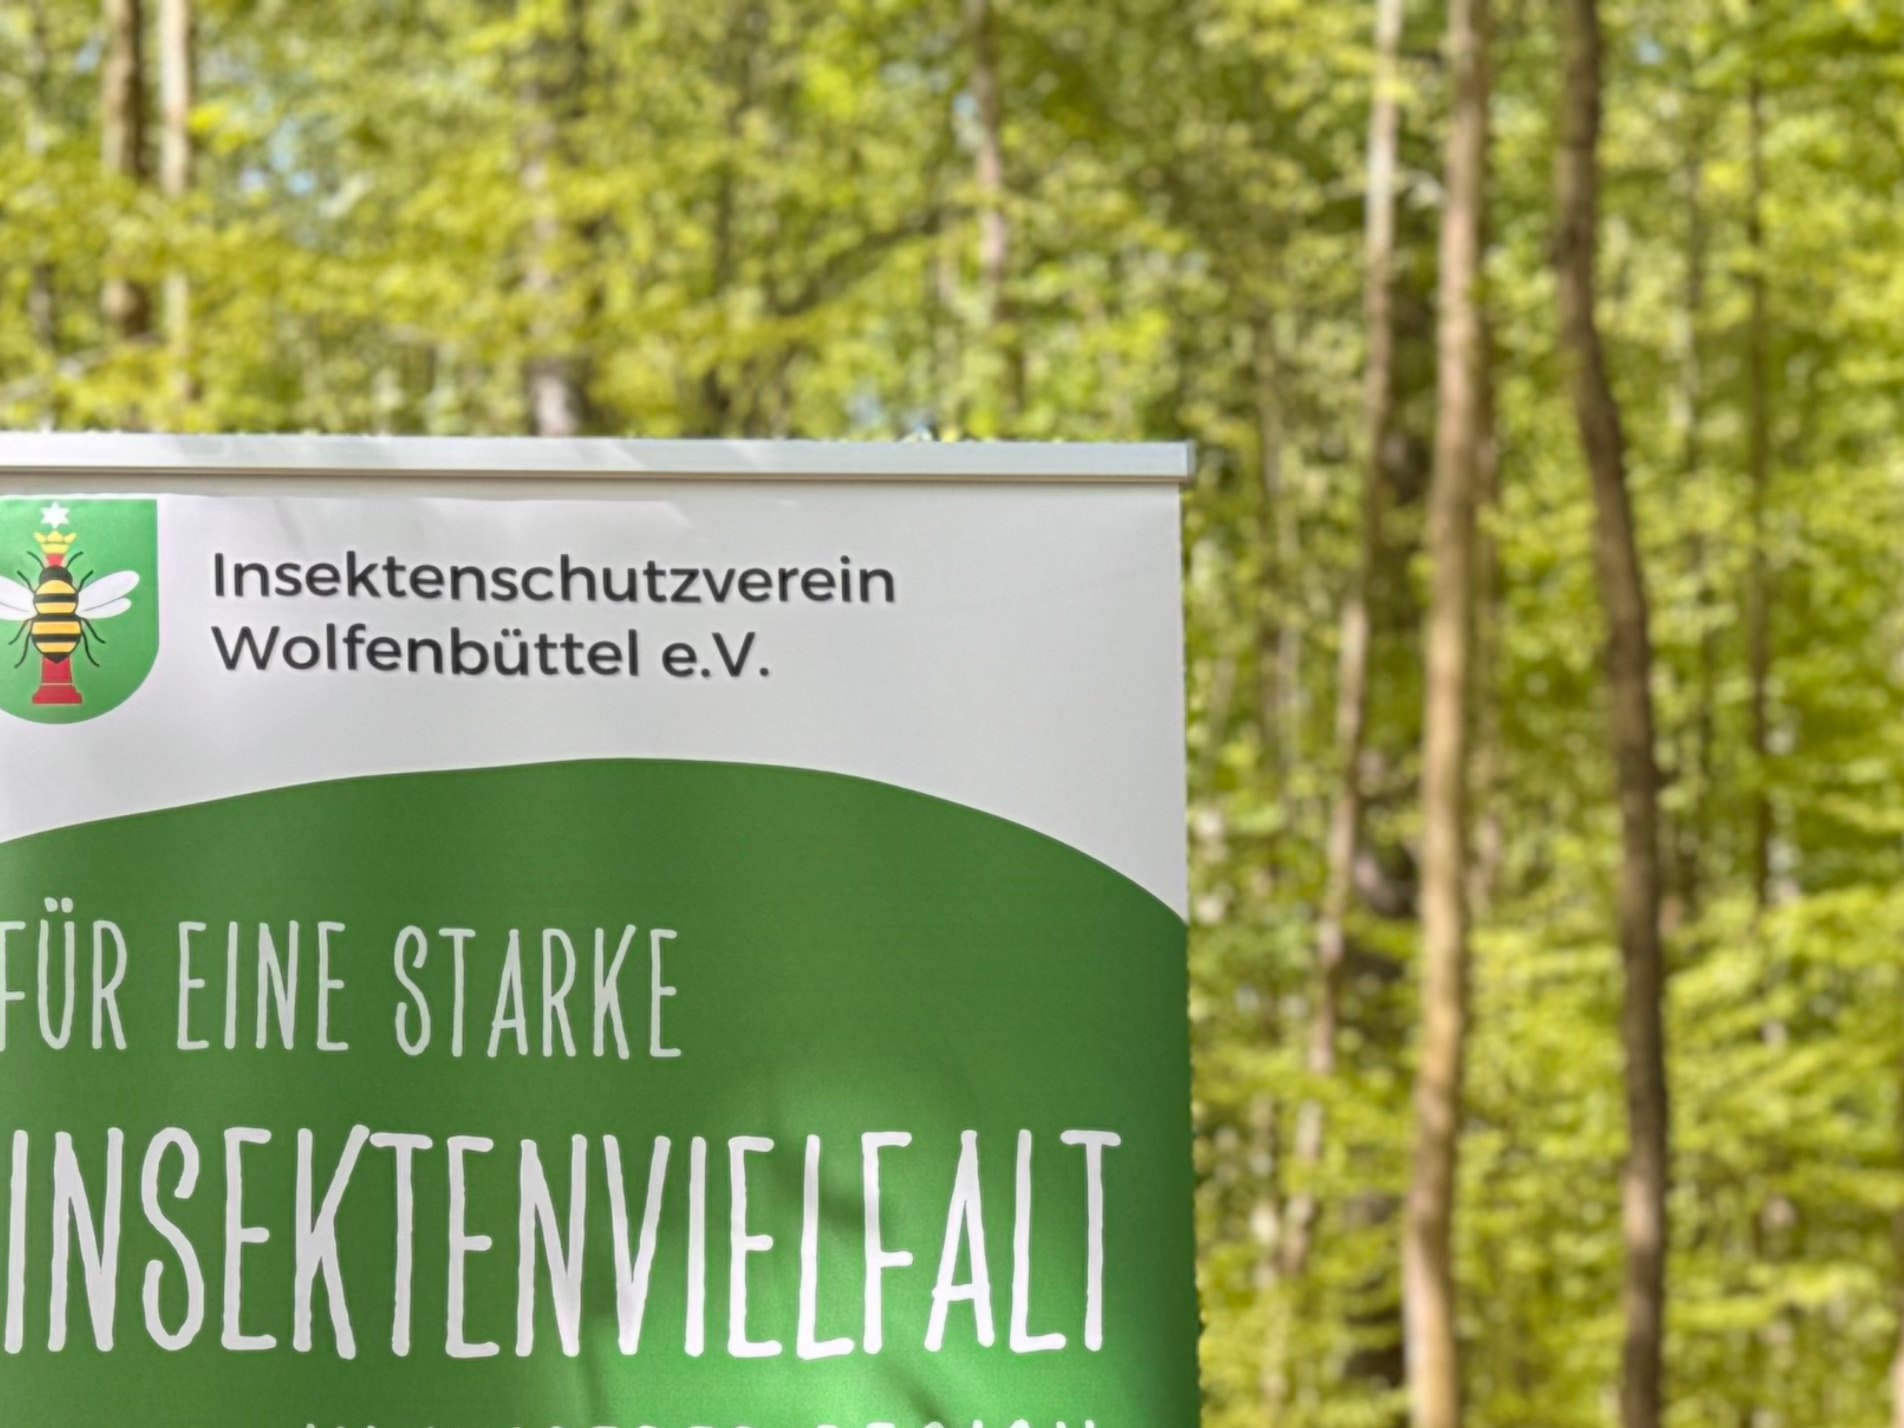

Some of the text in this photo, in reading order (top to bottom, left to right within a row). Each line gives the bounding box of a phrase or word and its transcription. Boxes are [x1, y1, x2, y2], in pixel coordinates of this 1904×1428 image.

[214, 550, 896, 604] Insektenschutzverein
[210, 622, 770, 679] Wolfenbüttel e.V.
[176, 919, 350, 1052] EINE
[393, 923, 683, 1061] STARKE
[3, 1123, 1123, 1362] INSEKTENVIELFALT
